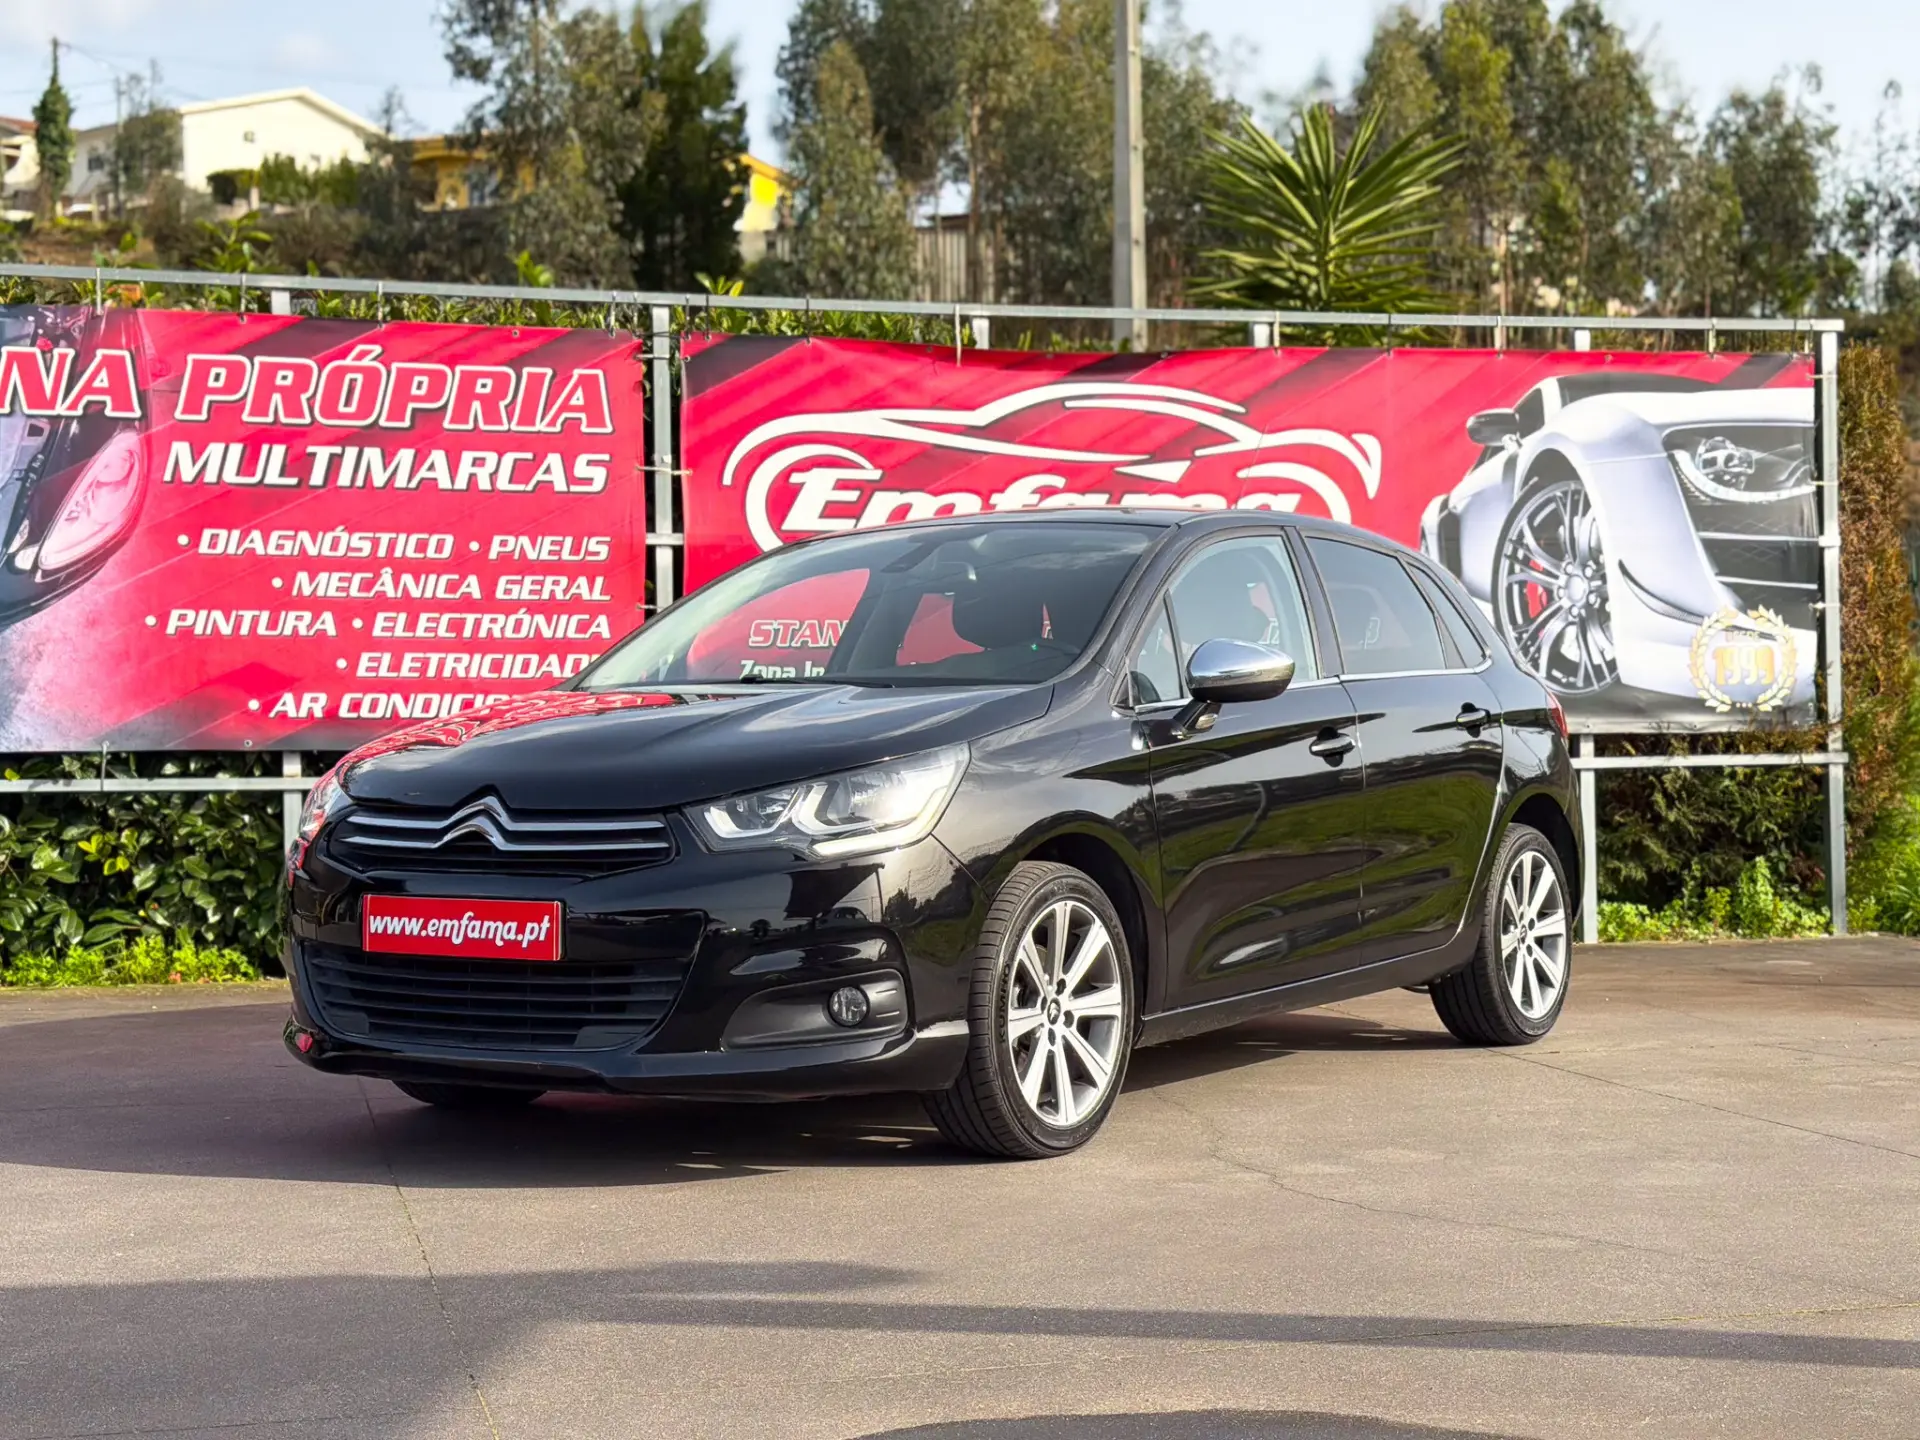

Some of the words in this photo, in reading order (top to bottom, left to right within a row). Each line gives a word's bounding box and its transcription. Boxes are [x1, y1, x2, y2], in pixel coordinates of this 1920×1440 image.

[174, 344, 613, 434] PRÓPRIA
[163, 441, 610, 493] MULTIMARCAS
[198, 525, 455, 561] DIAGNÓSTICO
[489, 535, 611, 561] PNEUS
[292, 567, 482, 600] MECÂNICA
[495, 575, 611, 601] GERAL
[166, 610, 337, 637] PINTURA
[372, 608, 612, 640] ELECTRÓNICA
[356, 652, 601, 679] ELETRICIDAD
[1713, 646, 1774, 685] 1999
[269, 692, 328, 718] AR
[338, 693, 522, 719] CONDICI
[369, 911, 550, 947] www.emfama.pt
